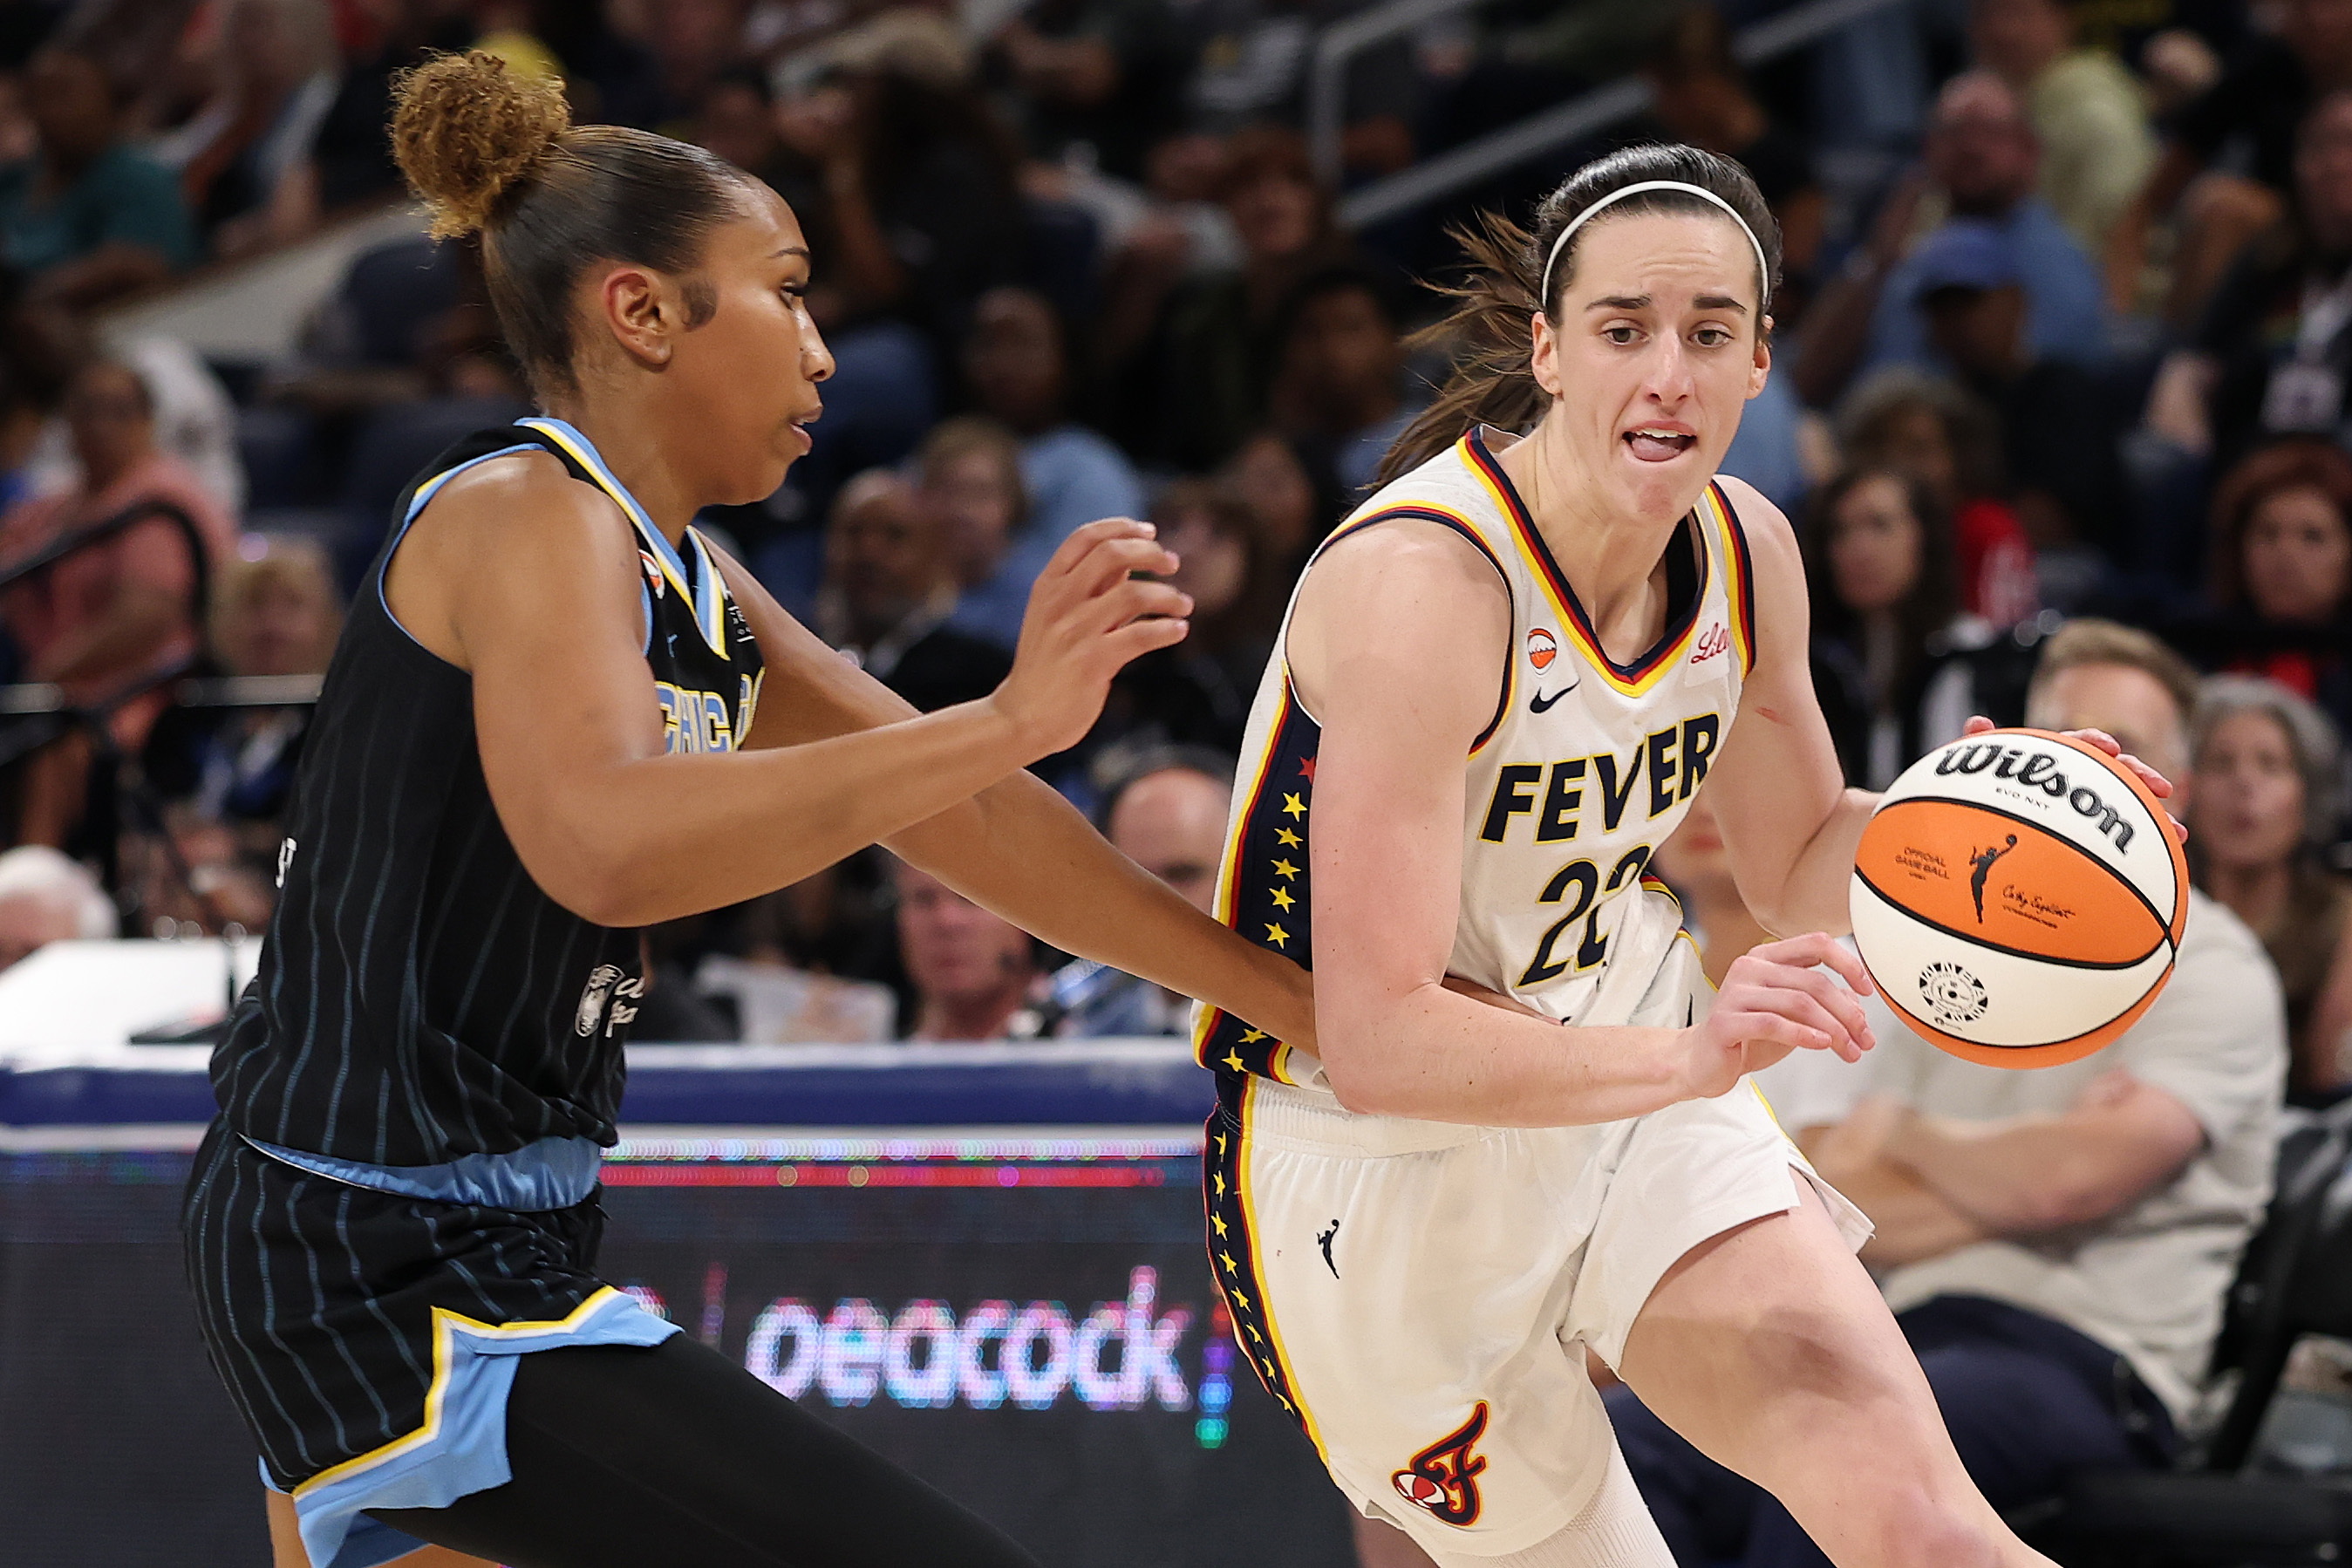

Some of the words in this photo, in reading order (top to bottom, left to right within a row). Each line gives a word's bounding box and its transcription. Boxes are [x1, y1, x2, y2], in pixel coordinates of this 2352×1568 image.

[1479, 712, 1721, 844] FEVER
[1935, 745, 2135, 856] Wilson
[1513, 842, 1651, 988] 22
